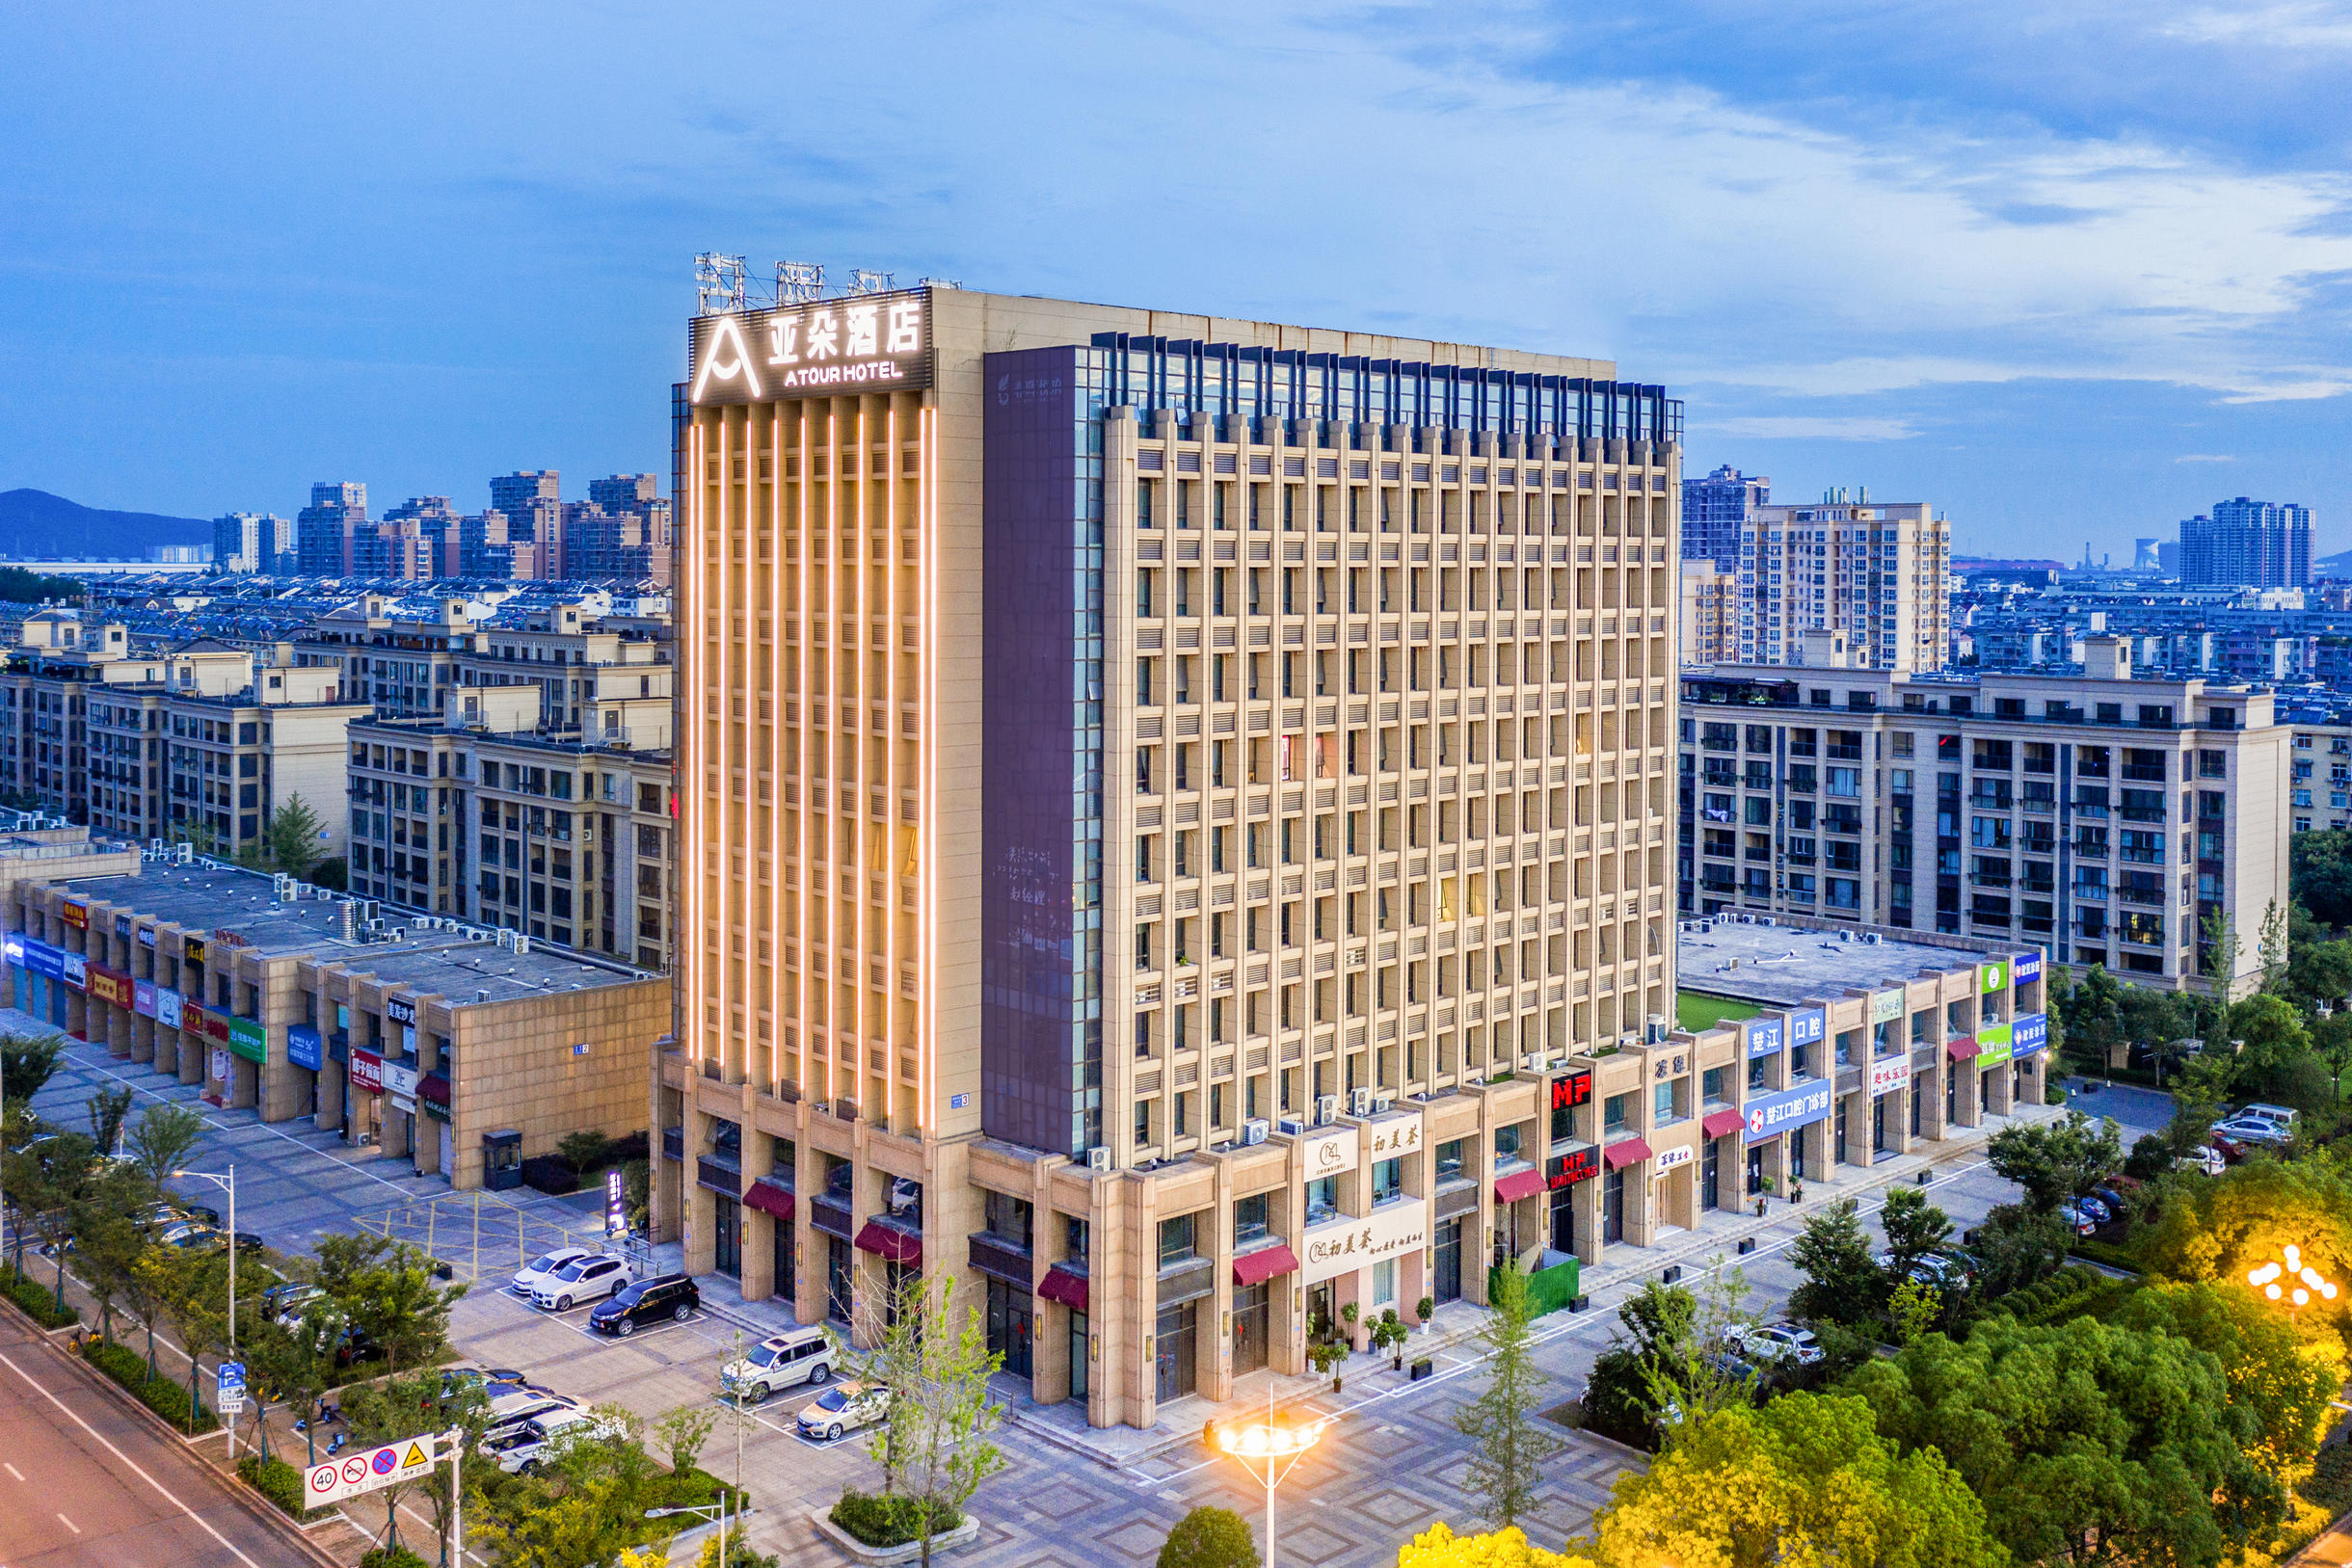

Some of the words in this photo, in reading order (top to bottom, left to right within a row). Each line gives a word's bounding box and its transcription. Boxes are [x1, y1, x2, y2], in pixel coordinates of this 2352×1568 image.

[769, 302, 920, 364] 亚朵酒店
[785, 367, 840, 386] ATOUR
[843, 361, 903, 381] HOTEL
[1752, 1028, 1778, 1052] 楚江
[1795, 1018, 1820, 1040] 口腔
[963, 1095, 968, 1105] 3
[1553, 1074, 1590, 1109] MP
[1766, 1090, 1829, 1125] 楚江口腔门诊部
[1563, 1152, 1586, 1172] MP
[316, 1473, 333, 1485] 40
